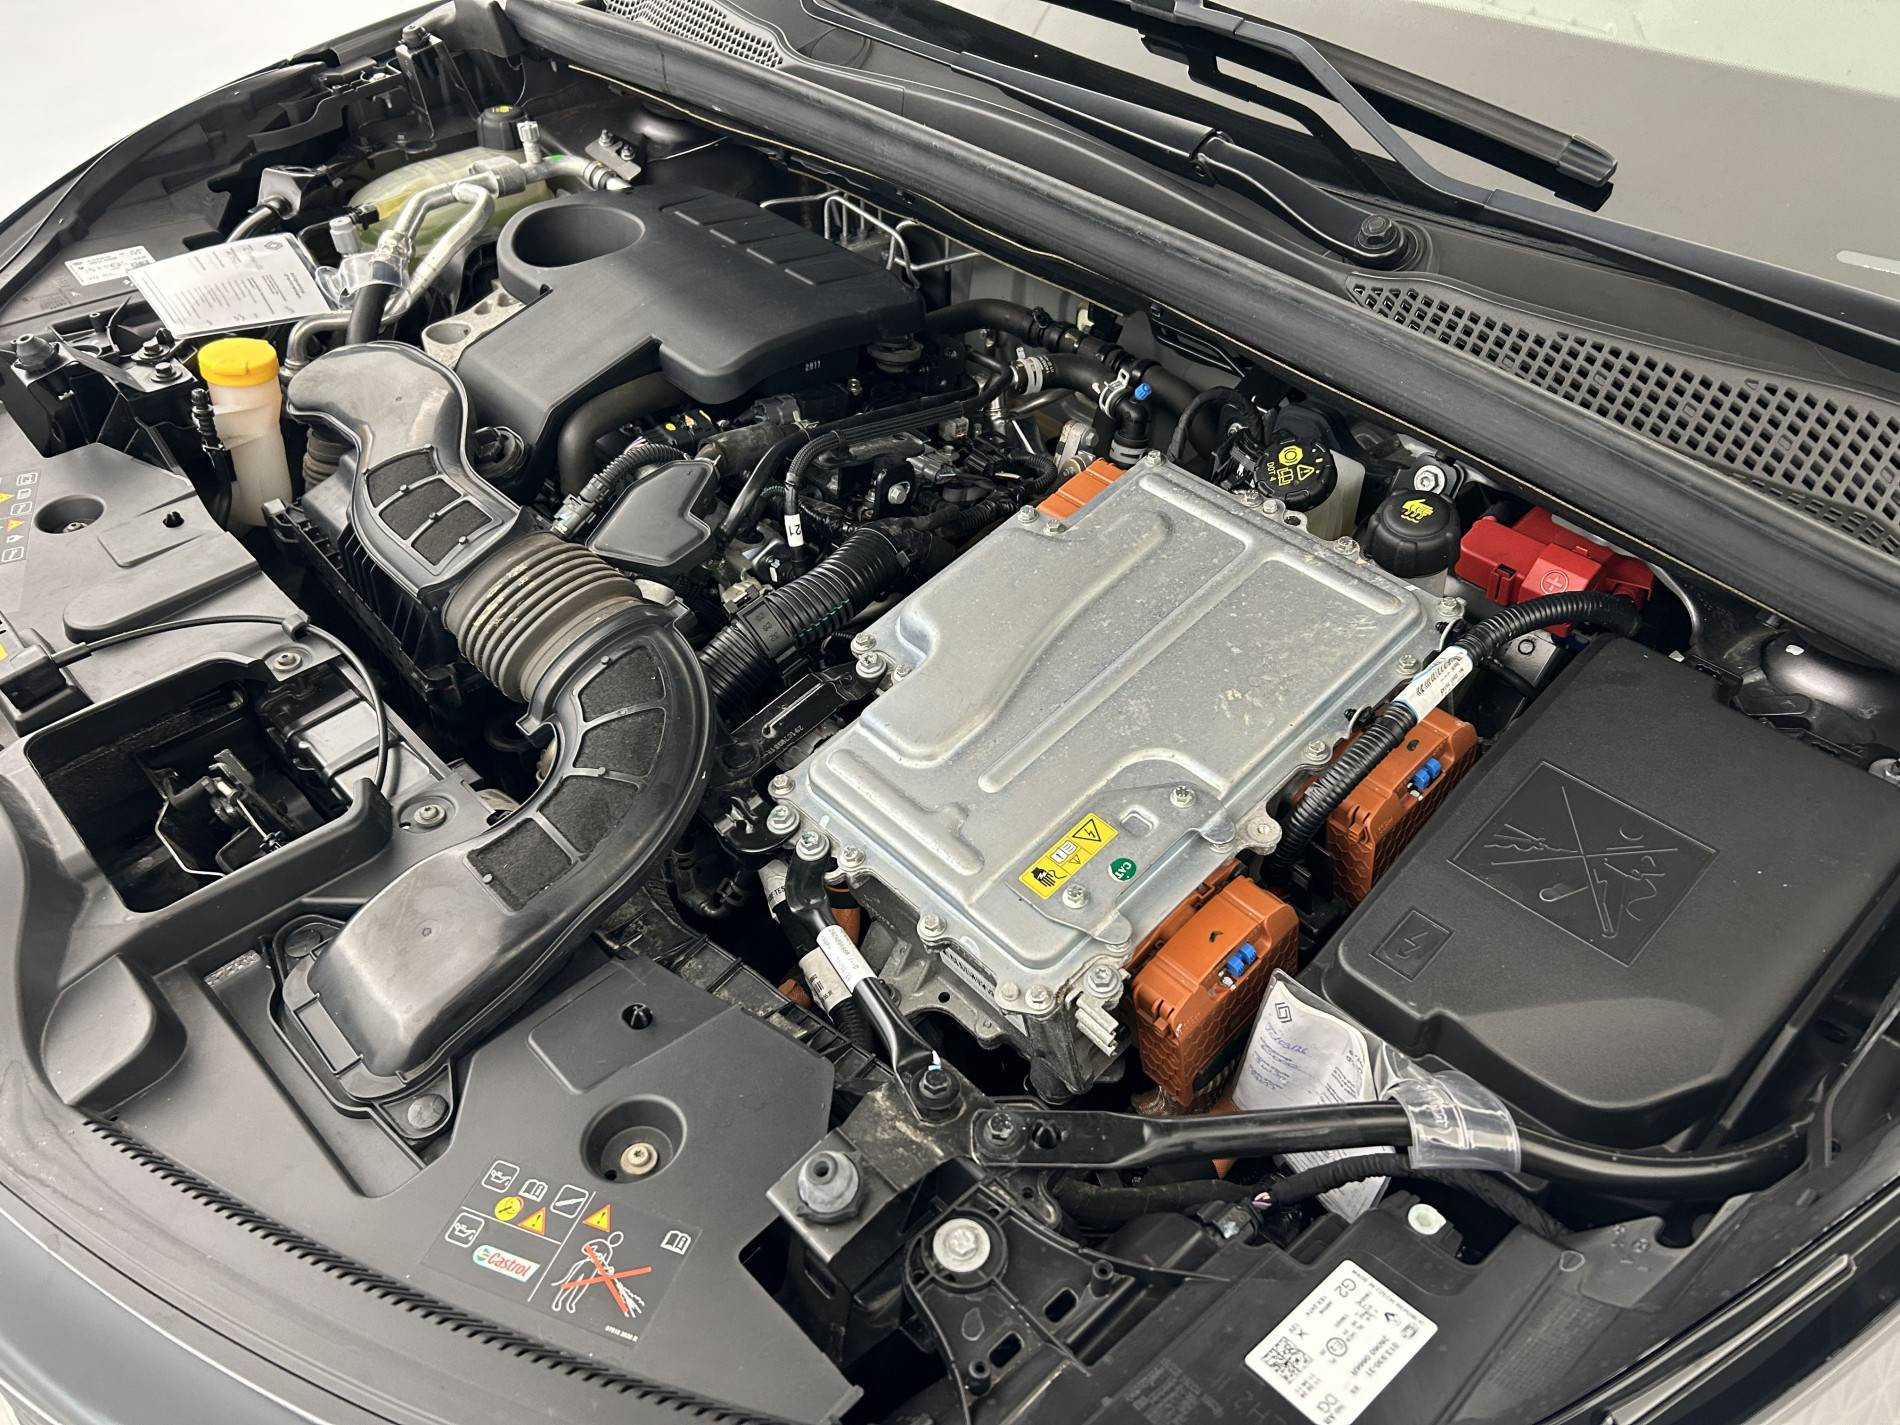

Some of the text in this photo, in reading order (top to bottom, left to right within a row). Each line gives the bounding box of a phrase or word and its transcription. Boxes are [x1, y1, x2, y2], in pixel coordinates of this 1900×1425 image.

[1267, 461, 1275, 474] DOT
[1114, 861, 1132, 879] CAT
[487, 1251, 531, 1277] Castrol
[1334, 1277, 1357, 1298] G2
[1316, 1393, 1338, 1414] DG
